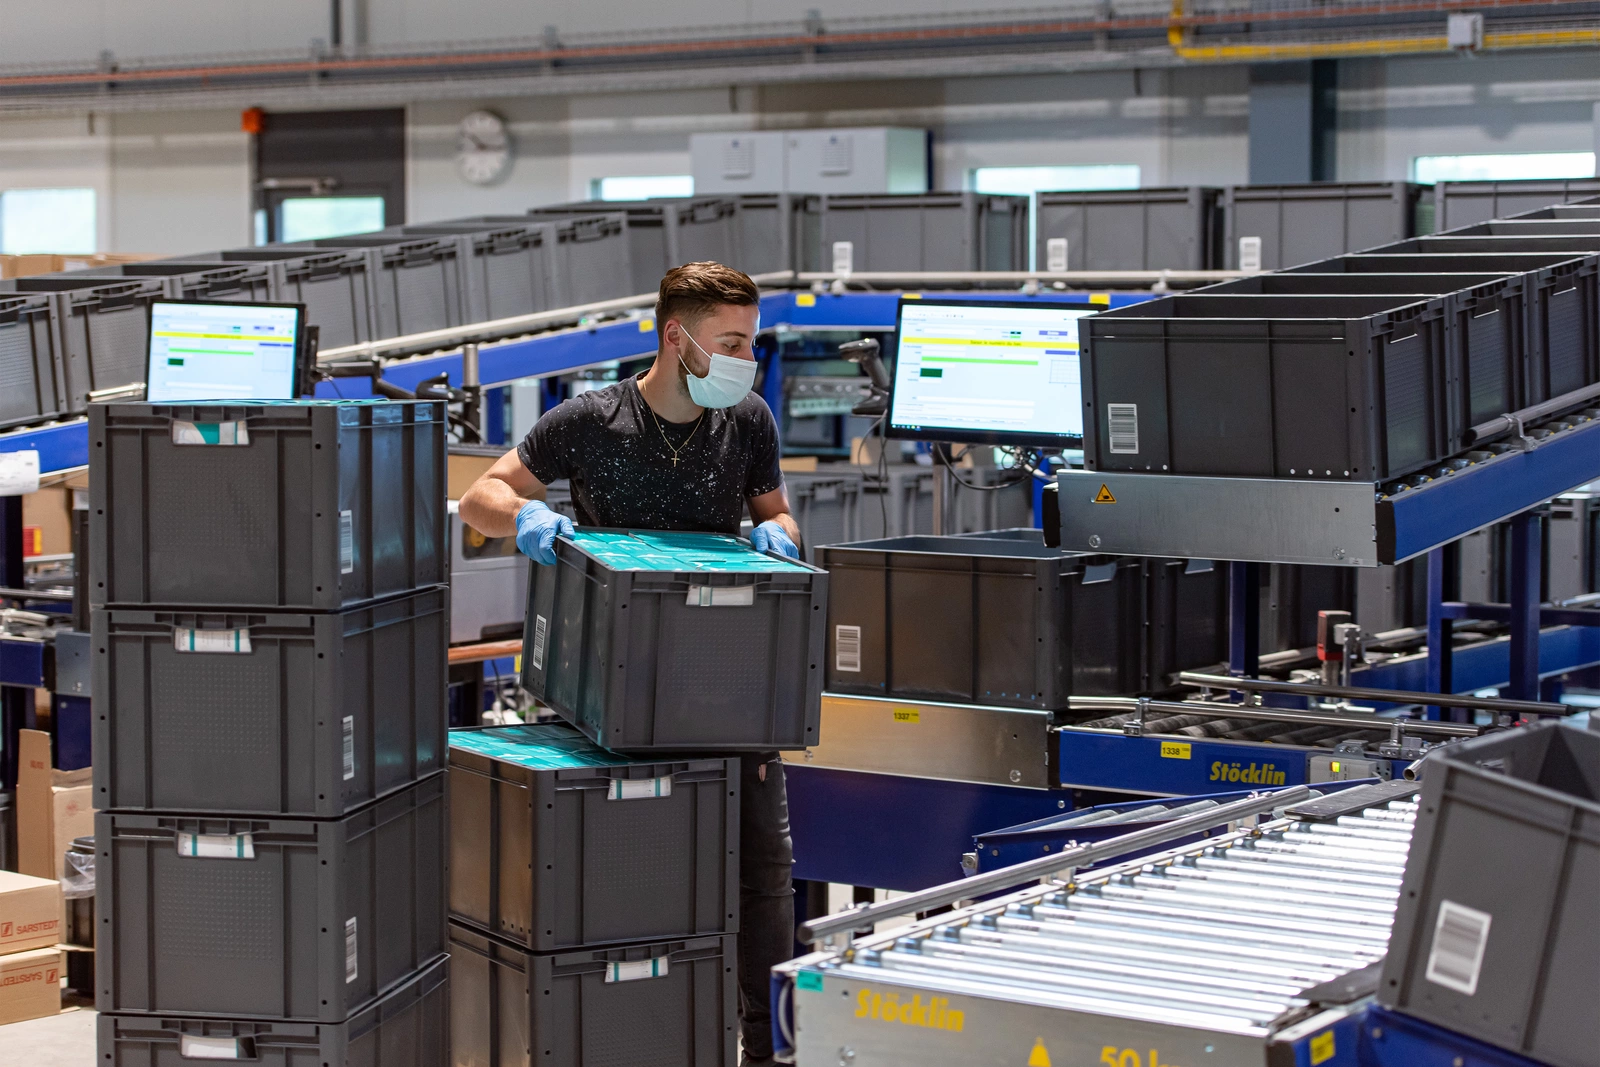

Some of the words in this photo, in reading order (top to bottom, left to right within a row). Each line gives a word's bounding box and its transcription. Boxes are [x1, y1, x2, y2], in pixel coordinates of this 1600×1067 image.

[894, 712, 910, 720] 1337
[1162, 747, 1180, 756] 1338
[1209, 761, 1286, 786] Stöcklin
[16, 919, 59, 935] SARSTEDT
[855, 988, 965, 1033] Stöcklin
